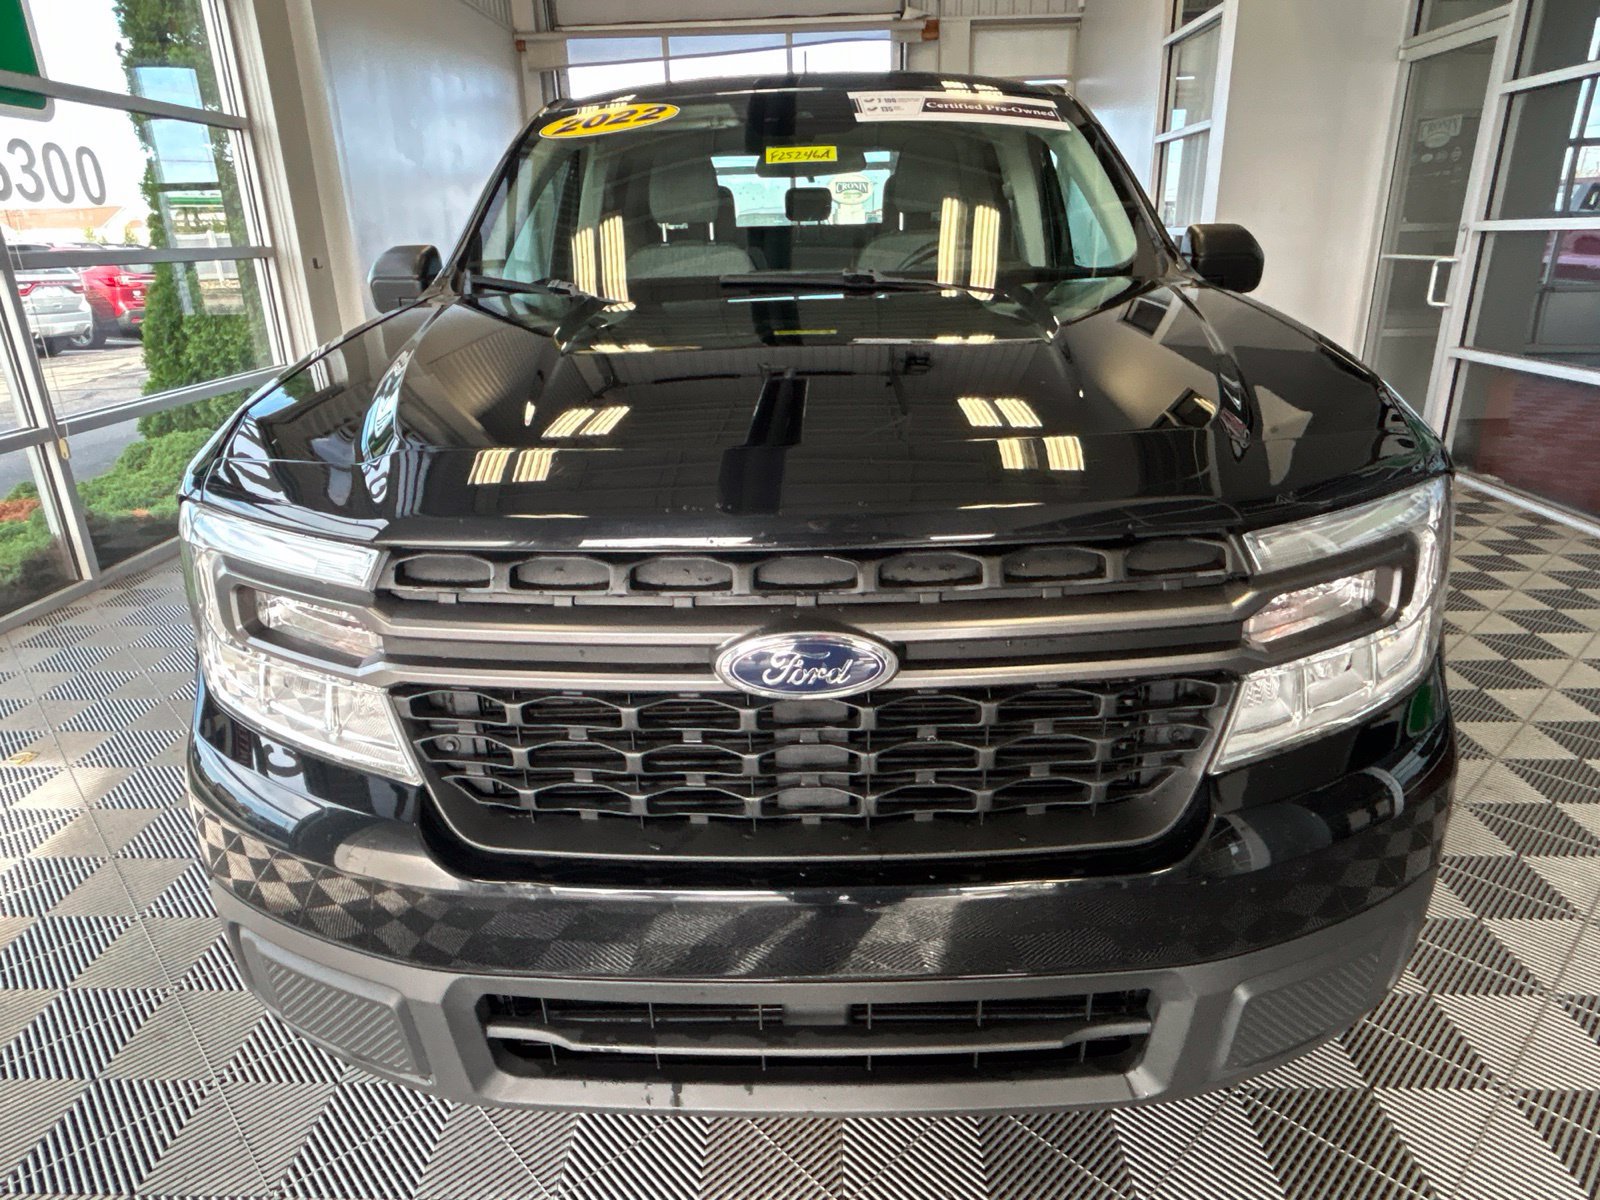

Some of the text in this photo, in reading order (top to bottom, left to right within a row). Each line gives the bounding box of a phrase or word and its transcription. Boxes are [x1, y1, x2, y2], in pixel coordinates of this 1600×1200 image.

[926, 101, 1056, 117] Certified Pre-Owned
[551, 106, 668, 135] 2022
[836, 182, 867, 193] CRONIN
[762, 650, 853, 686] Ford
